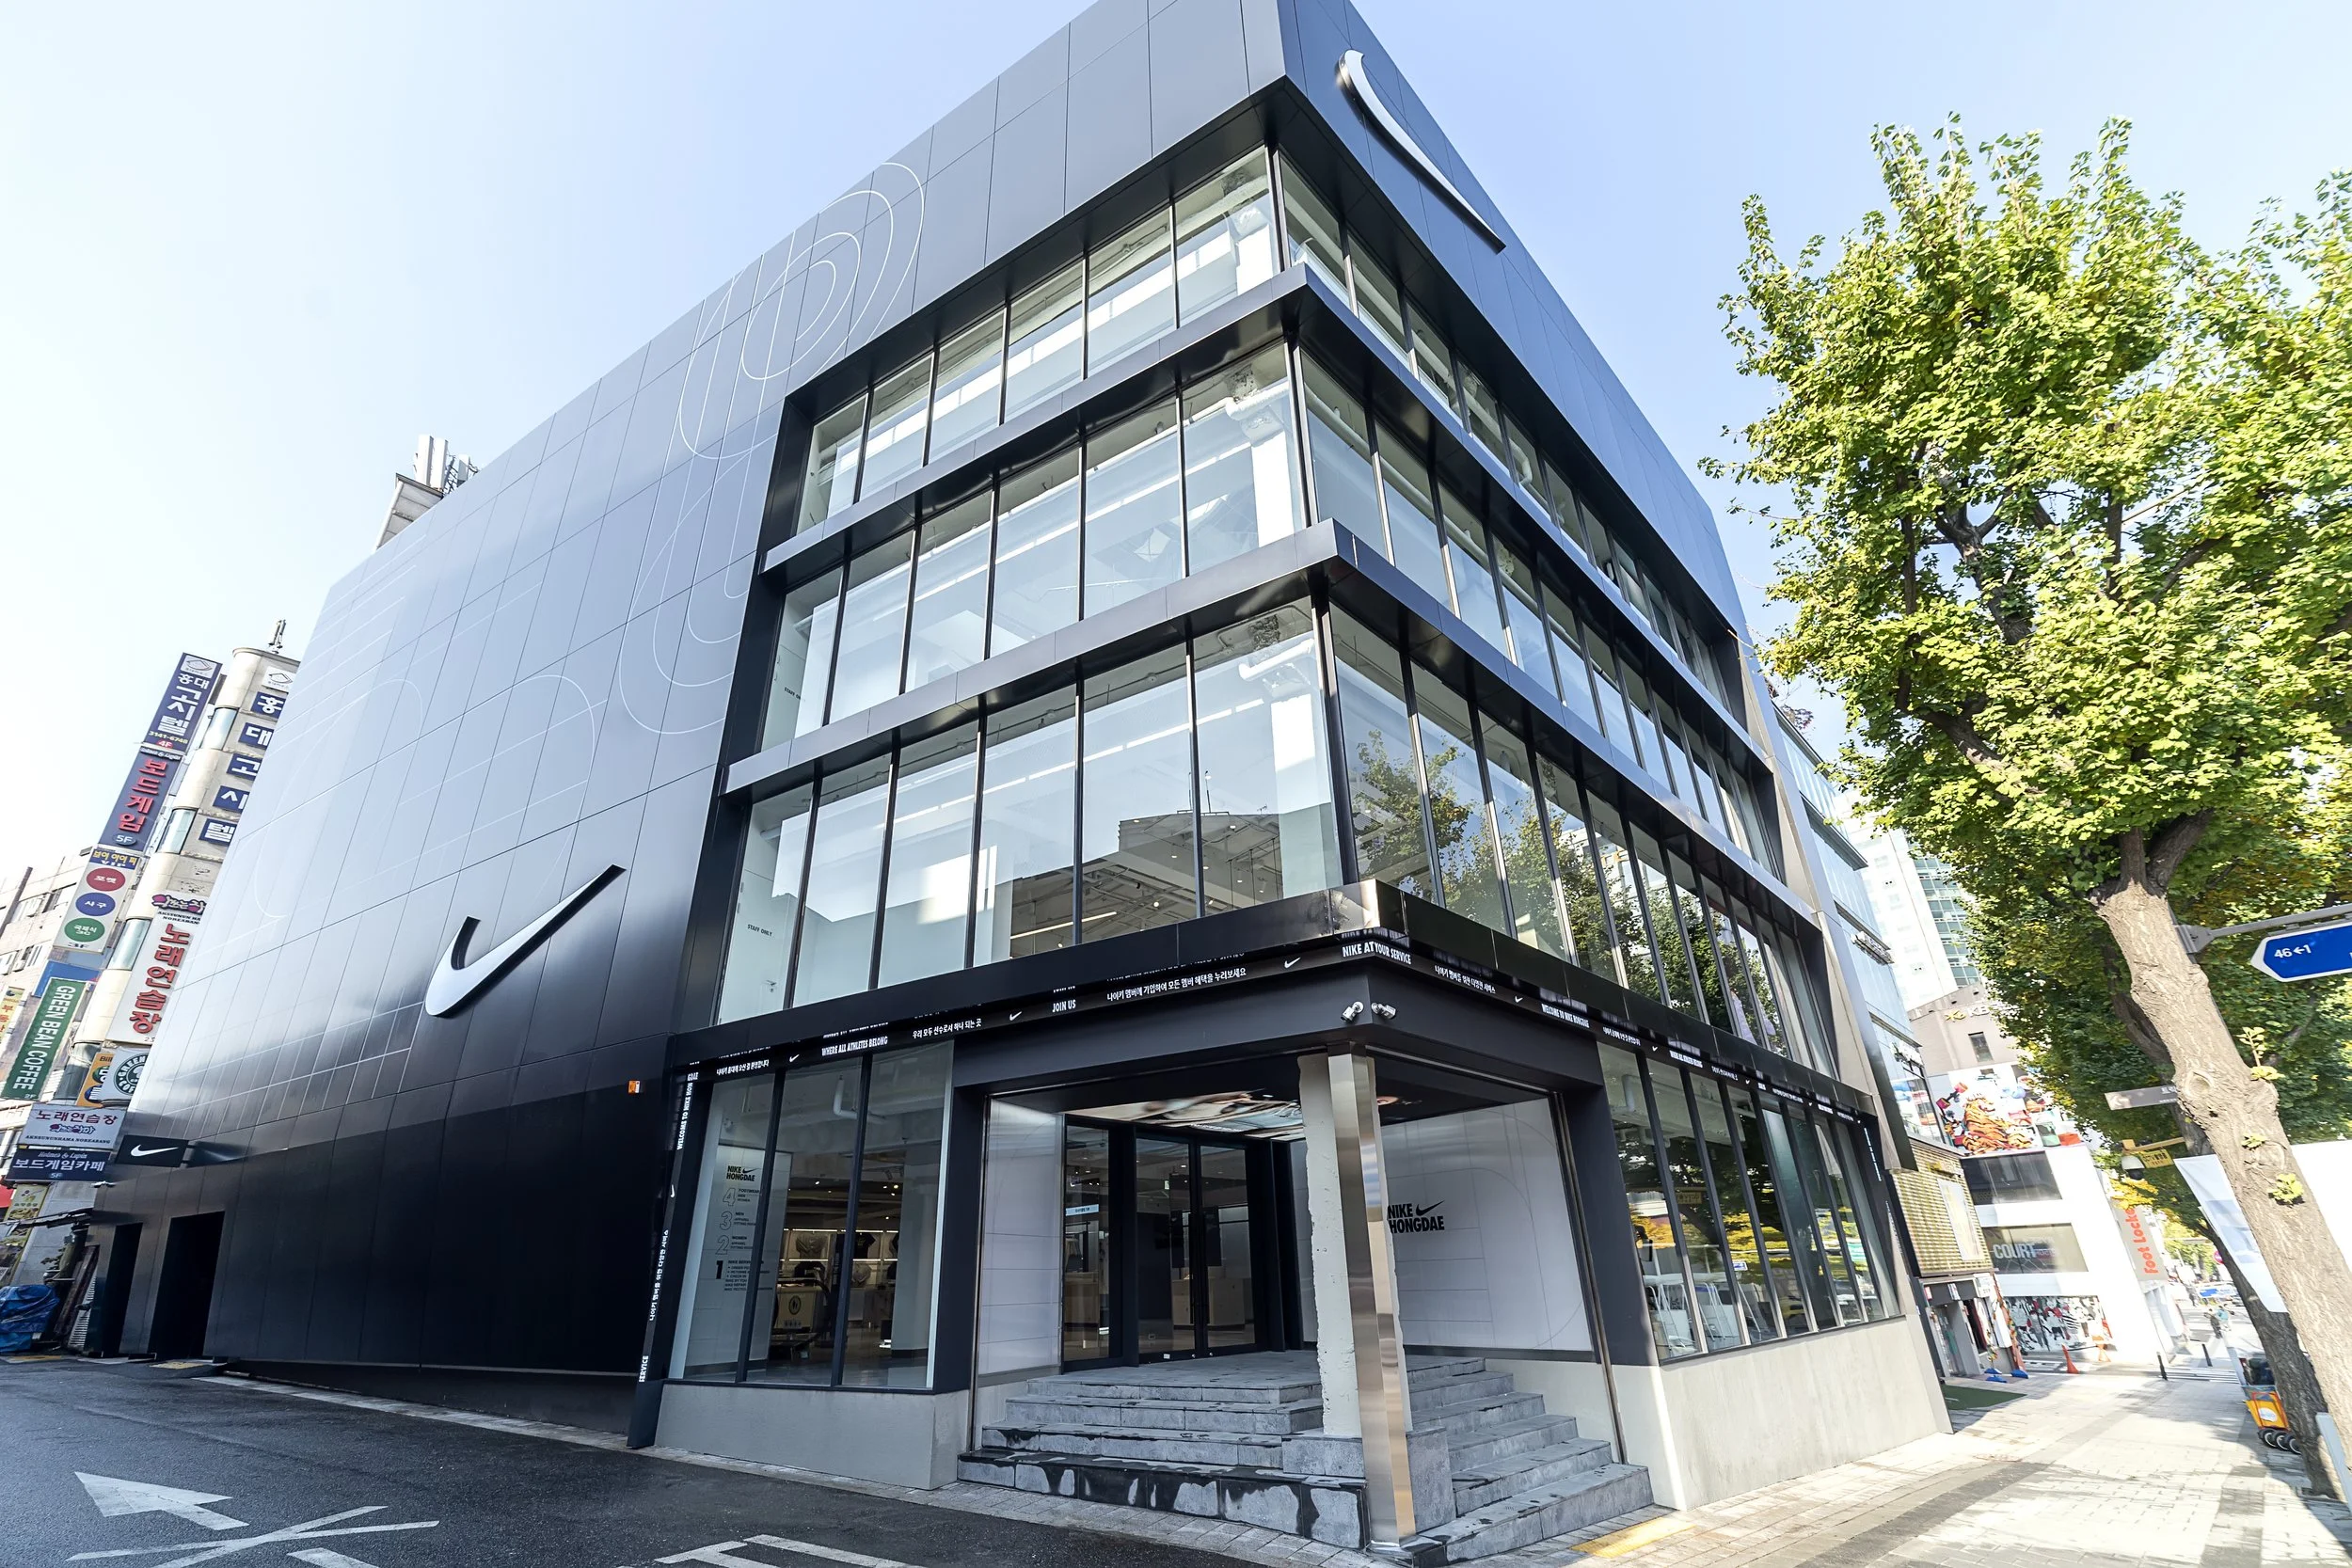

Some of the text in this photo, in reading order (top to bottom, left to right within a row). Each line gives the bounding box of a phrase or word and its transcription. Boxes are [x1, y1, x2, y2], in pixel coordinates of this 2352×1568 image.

[178, 673, 210, 689] 홍대
[158, 686, 202, 736] 고시텔
[119, 758, 167, 833] 보드게임
[116, 834, 133, 844] 5F
[748, 924, 760, 932] STAFF
[1342, 941, 1411, 965] NIKE AT YOUR SERVICE
[2274, 948, 2293, 958] 46
[129, 923, 191, 1034] 노래연습장
[1106, 989, 1124, 1001] 나이키
[1124, 986, 1143, 999] 멤버에
[1143, 981, 1168, 995] 가입하여
[1168, 979, 1180, 990] 모든
[1181, 976, 1194, 988] 멤버
[1195, 973, 1214, 986] 혜택을
[1215, 967, 1247, 982] 누리보세요
[1052, 999, 1076, 1013] JOIN US
[13, 985, 76, 1090] GREEN BEAN COFFEE
[913, 1018, 982, 1039] 우리 모두 선수로서 하나 되는 곳
[821, 1036, 888, 1056] WHERE ALL ATHLETES BELONG
[118, 1055, 147, 1077] GREEN
[683, 1096, 691, 1111] NIKE
[36, 1110, 119, 1125] 노래연습장
[681, 1111, 689, 1120] TO
[676, 1120, 688, 1150] WELCOME
[13, 1159, 105, 1172] 보드게임카페
[726, 1173, 755, 1181] HONGDAE
[723, 1187, 736, 1206] 4
[720, 1211, 732, 1230] 3
[1388, 1203, 1413, 1219] NIKE
[1389, 1215, 1445, 1234] HONGDAE
[715, 1234, 730, 1255] 2
[2124, 1205, 2159, 1274] Foot Locke
[1993, 1242, 2038, 1259] COURT
[716, 1260, 723, 1279] 1
[649, 1302, 658, 1322] 나이키
[638, 1355, 649, 1383] SERVICE
